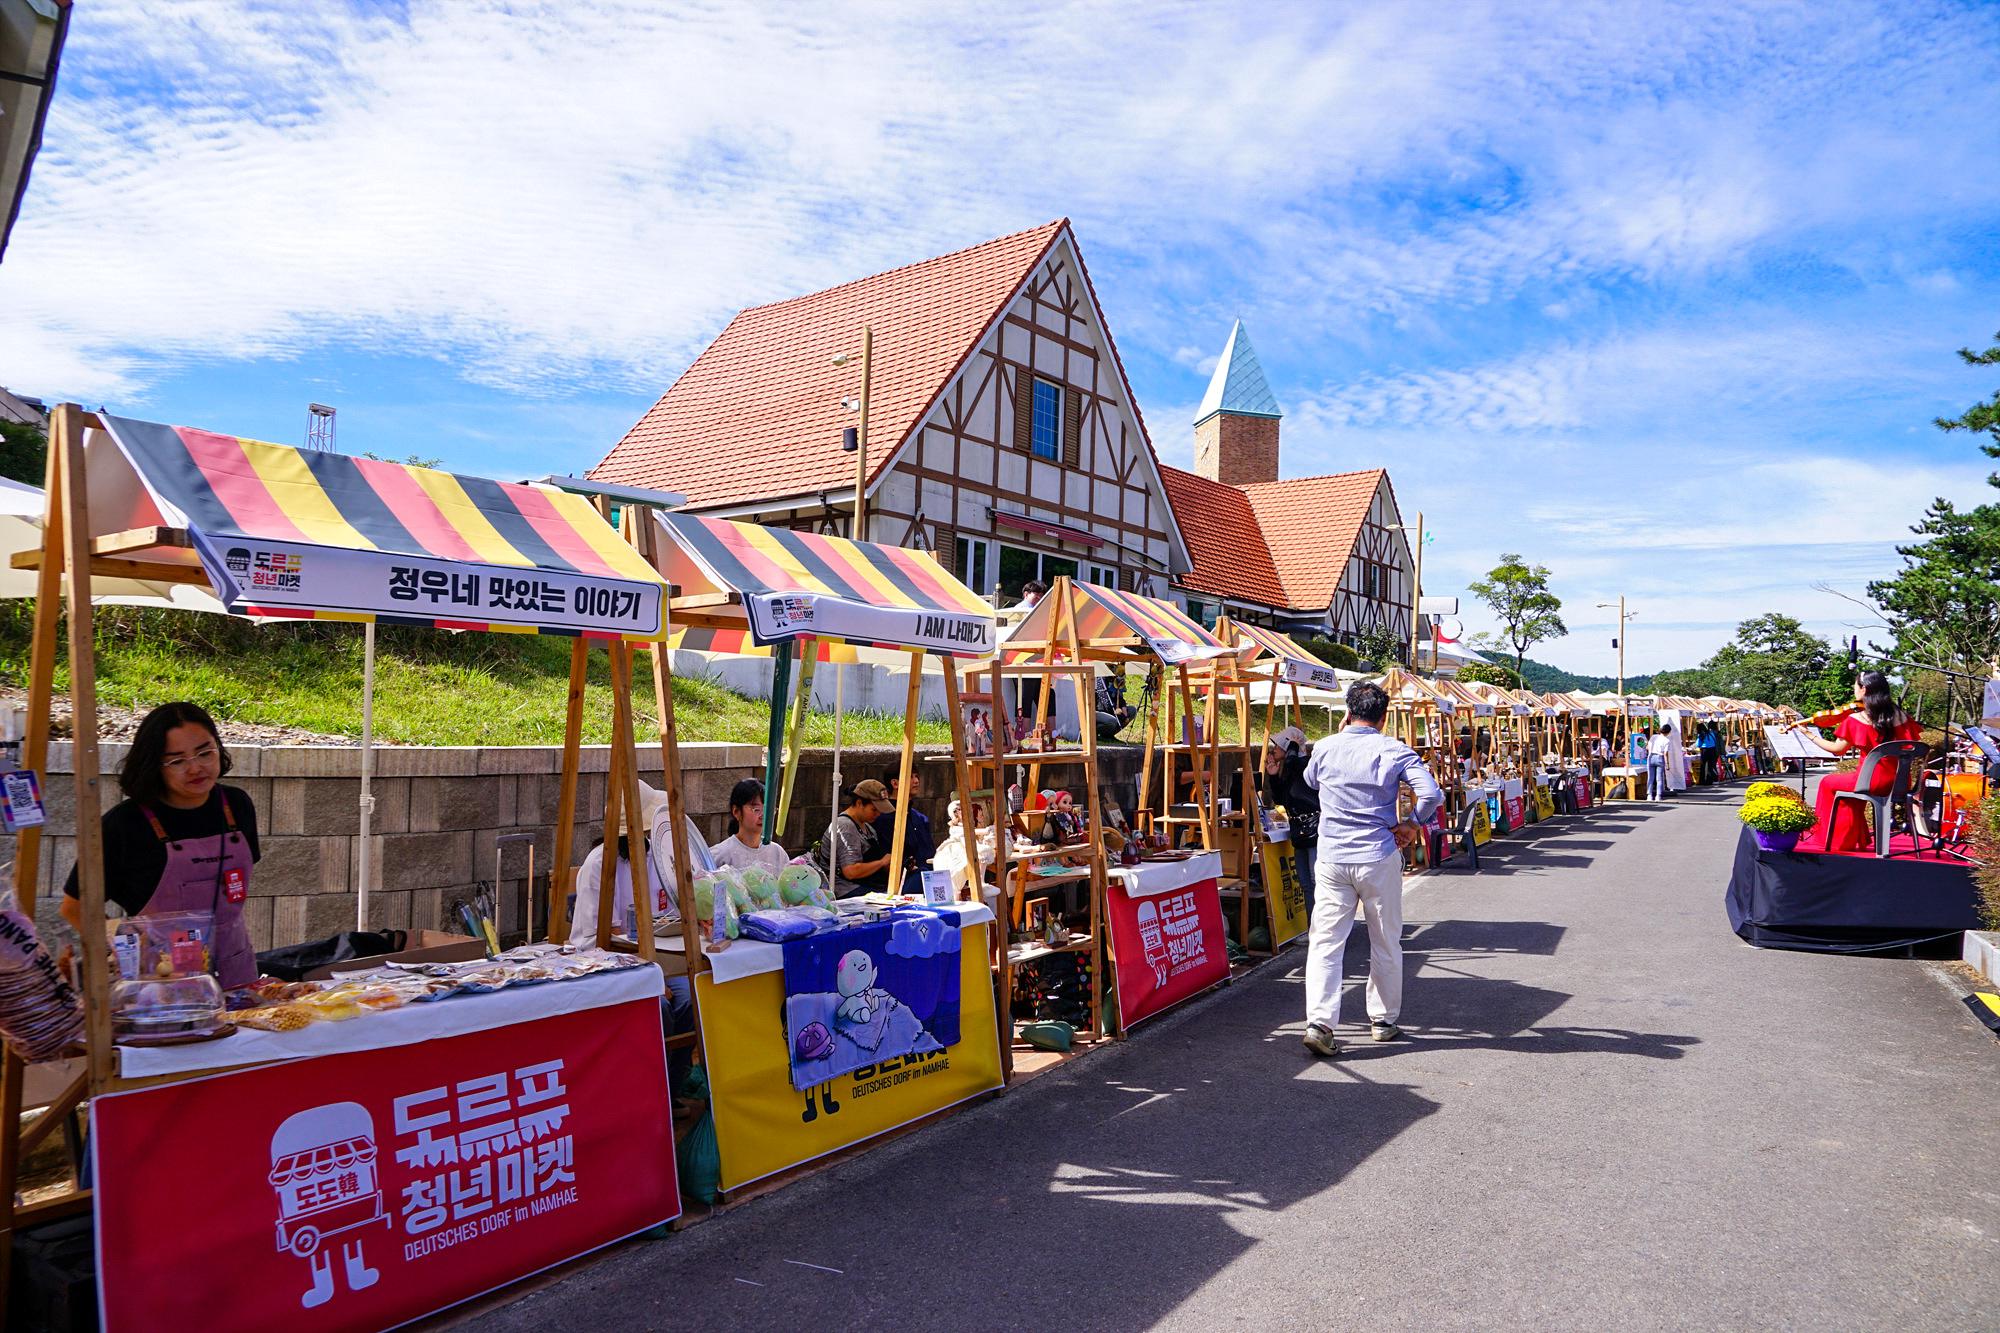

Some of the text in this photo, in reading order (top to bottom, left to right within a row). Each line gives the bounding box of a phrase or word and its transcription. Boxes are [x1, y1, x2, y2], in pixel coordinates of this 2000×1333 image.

[253, 572, 301, 587] 청년마켓
[254, 552, 303, 573] 도르프
[389, 567, 641, 620] 정우네 맛있는 이야기
[915, 615, 987, 644] I AM 나매기
[852, 1076, 892, 1099] DEUTSCHES
[894, 1069, 912, 1085] DORF
[912, 1067, 921, 1080] im
[922, 1059, 950, 1077] NAMHAE
[393, 1058, 571, 1169] 도르프
[402, 1134, 576, 1235] 청년마켓
[404, 1186, 579, 1262] DEUTSCHES DORF im NAMHAE
